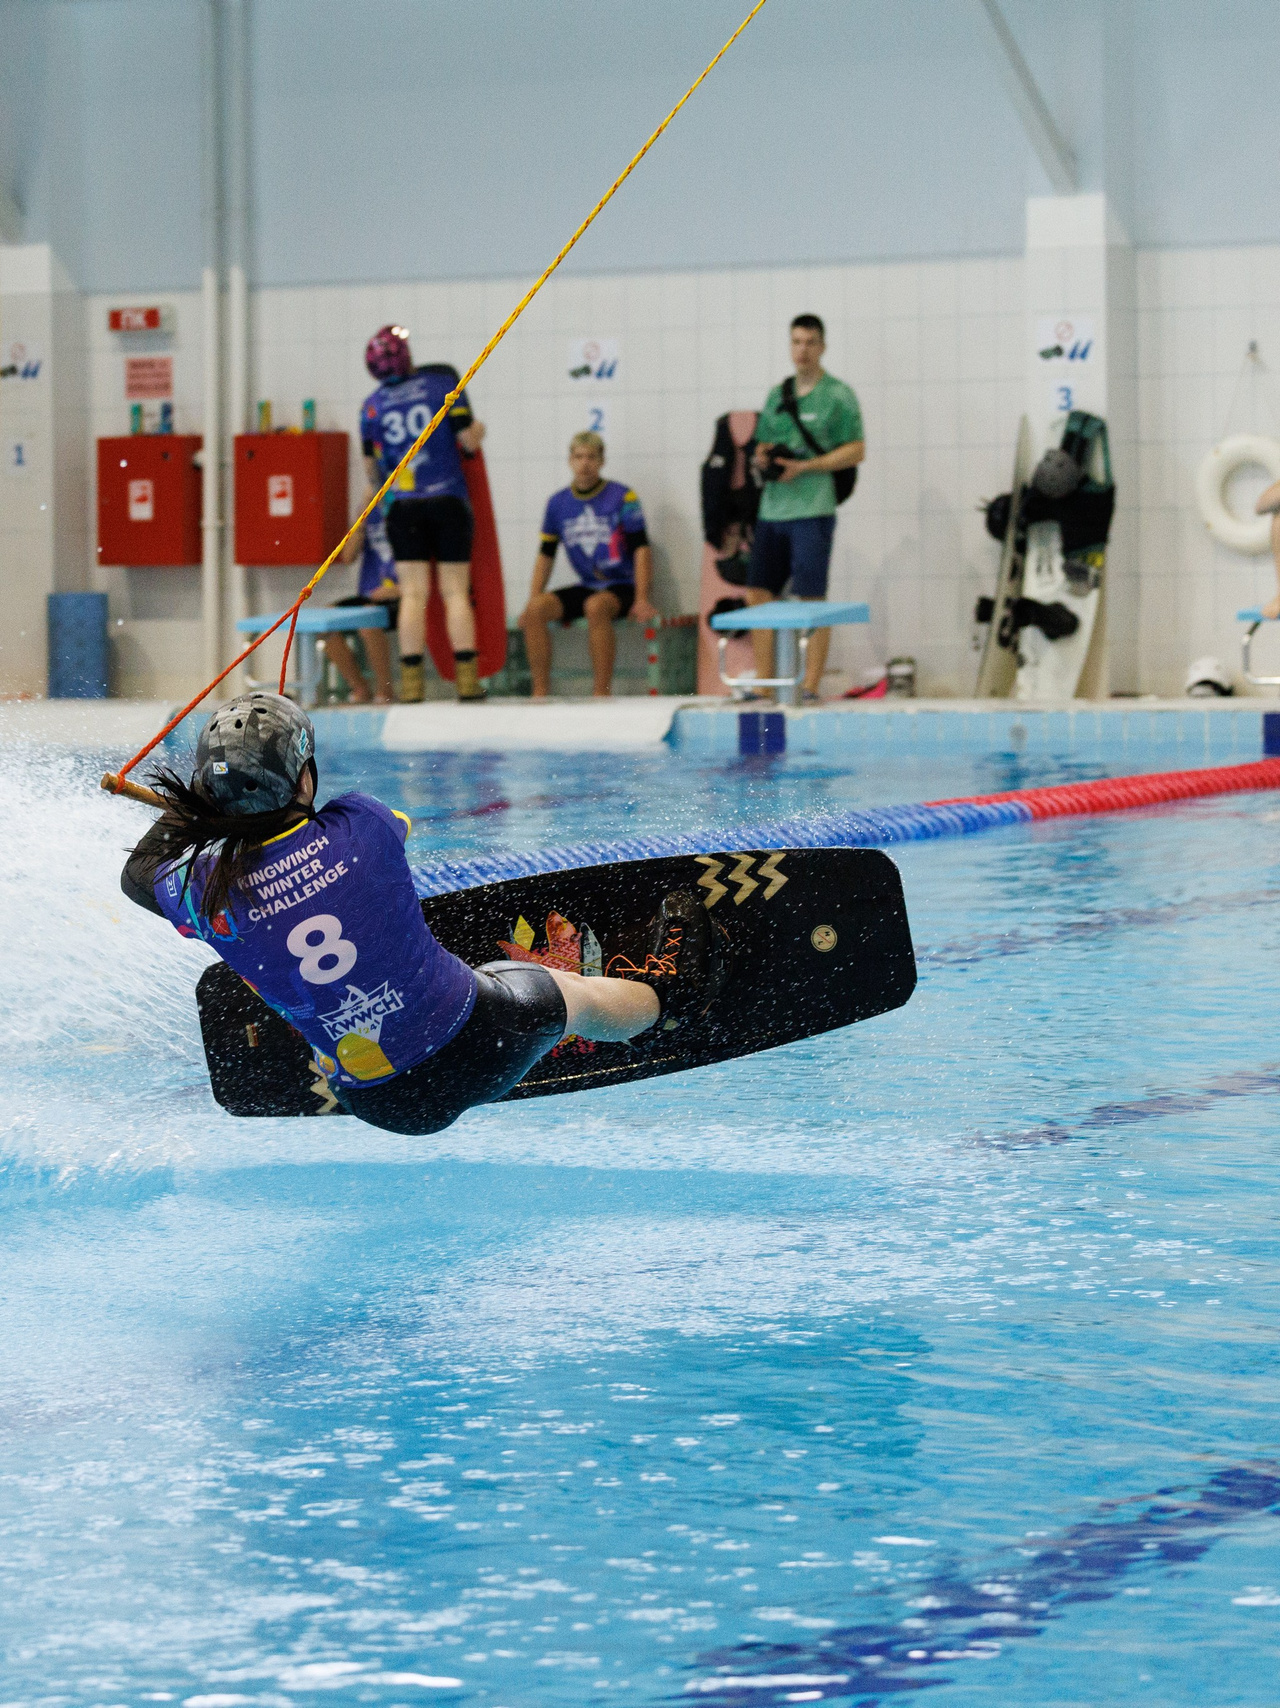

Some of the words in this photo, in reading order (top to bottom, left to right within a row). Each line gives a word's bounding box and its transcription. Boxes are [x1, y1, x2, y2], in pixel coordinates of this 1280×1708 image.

[588, 407, 604, 432] 2
[1057, 386, 1074, 411] 3
[381, 403, 432, 445] 30
[15, 444, 24, 466] 1
[248, 861, 349, 921] CHALLENGE
[257, 858, 324, 900] WINTER
[286, 914, 358, 985] 8
[327, 993, 401, 1038] KWWCH
